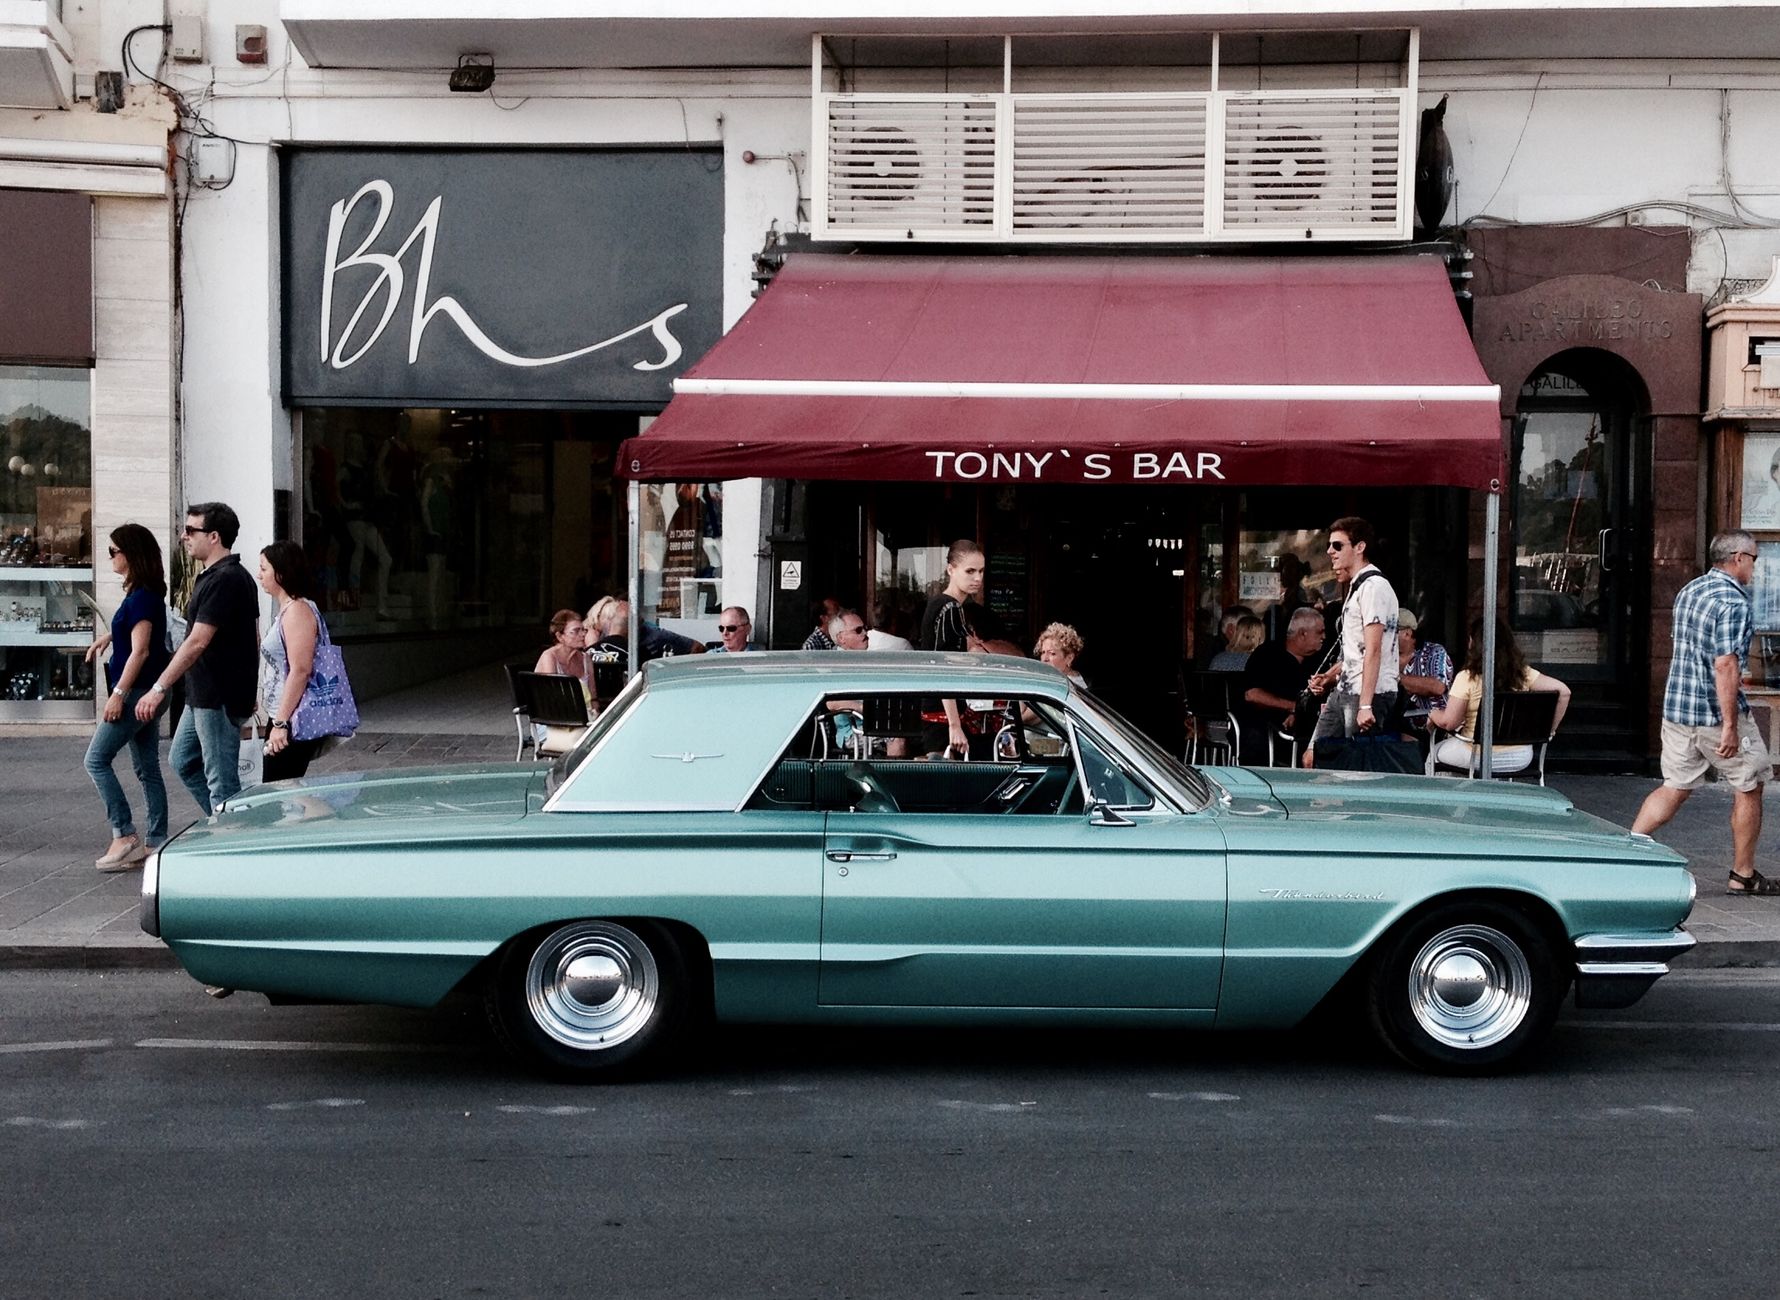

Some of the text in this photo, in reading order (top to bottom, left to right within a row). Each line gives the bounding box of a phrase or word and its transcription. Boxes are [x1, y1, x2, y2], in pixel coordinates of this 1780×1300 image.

[1531, 299, 1643, 320] GALILEO
[1499, 319, 1673, 343] APARTMENTS
[1530, 374, 1584, 390] GALIL
[1133, 452, 1226, 480] BAR
[309, 696, 344, 708] adidas
[1259, 888, 1385, 901] Thunderbird
